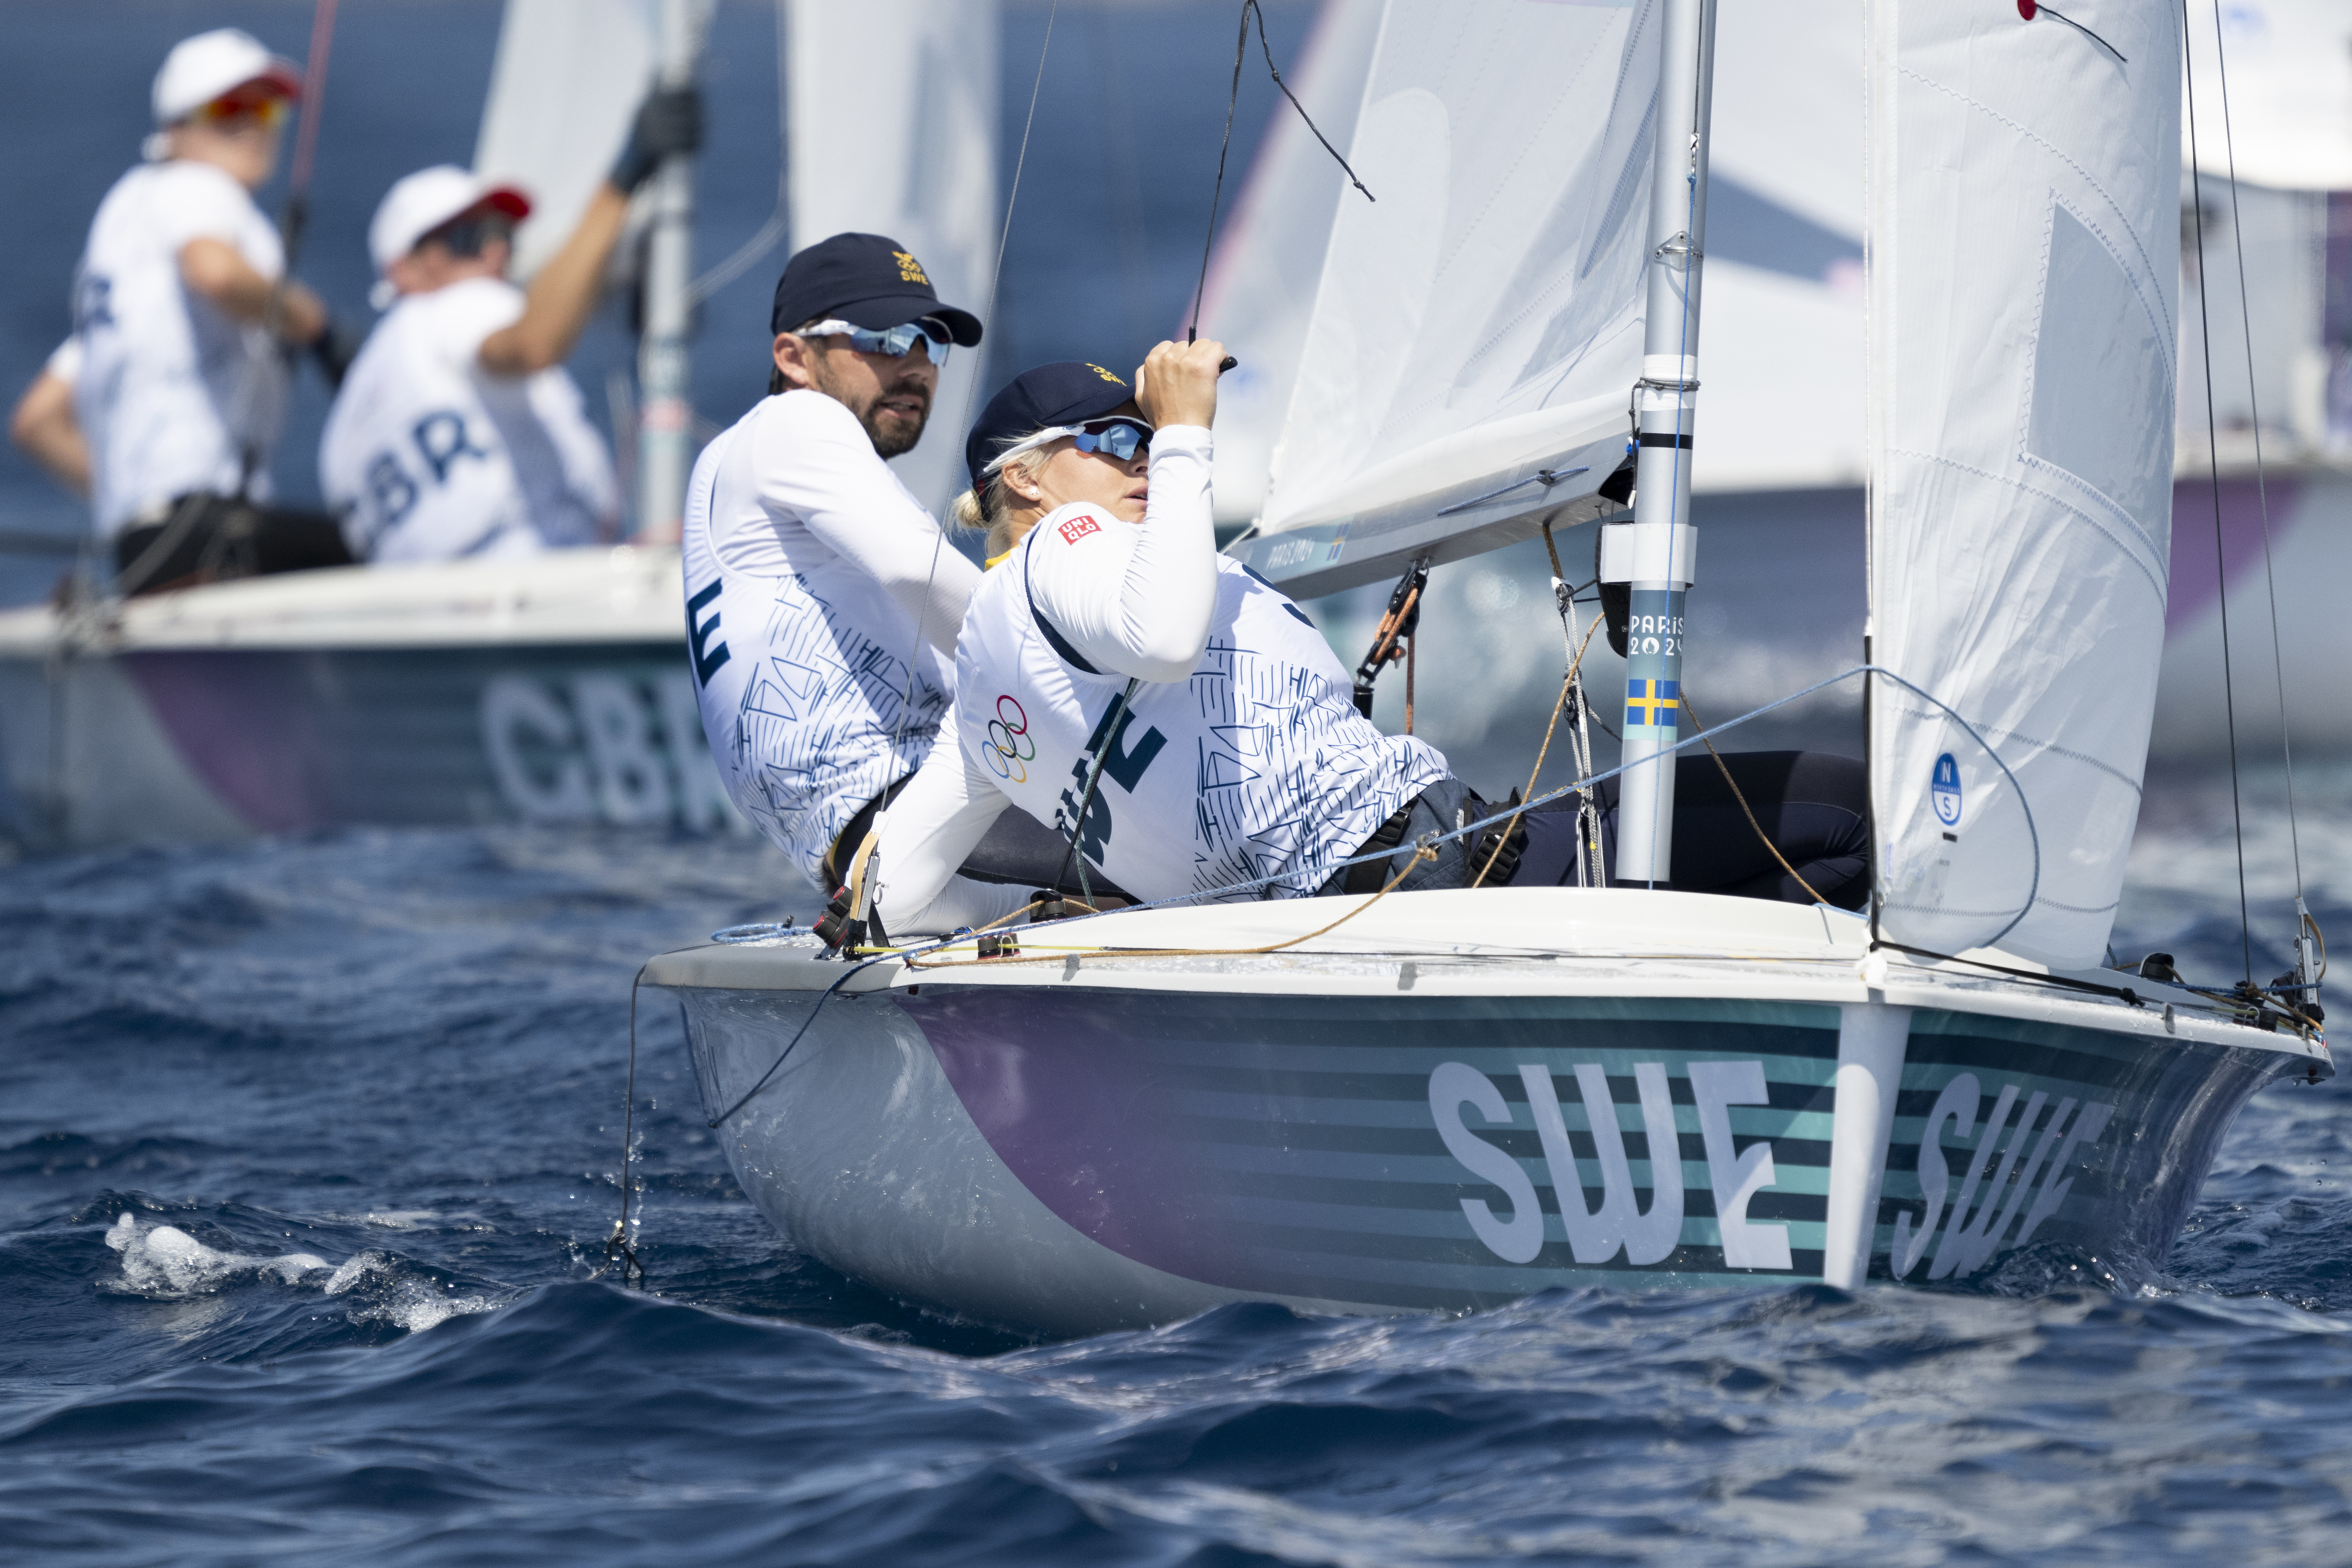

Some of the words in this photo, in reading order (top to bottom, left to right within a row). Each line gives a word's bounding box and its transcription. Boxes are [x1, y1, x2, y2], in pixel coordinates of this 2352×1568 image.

[901, 270, 929, 285] SWE
[1061, 517, 1090, 532] UNI
[1068, 524, 1096, 540] QLO
[687, 576, 732, 691] E
[1943, 762, 1952, 783] N
[1943, 796, 1952, 817] S
[1428, 1061, 1793, 1270] SWE
[1891, 1072, 2115, 1280] SWE
